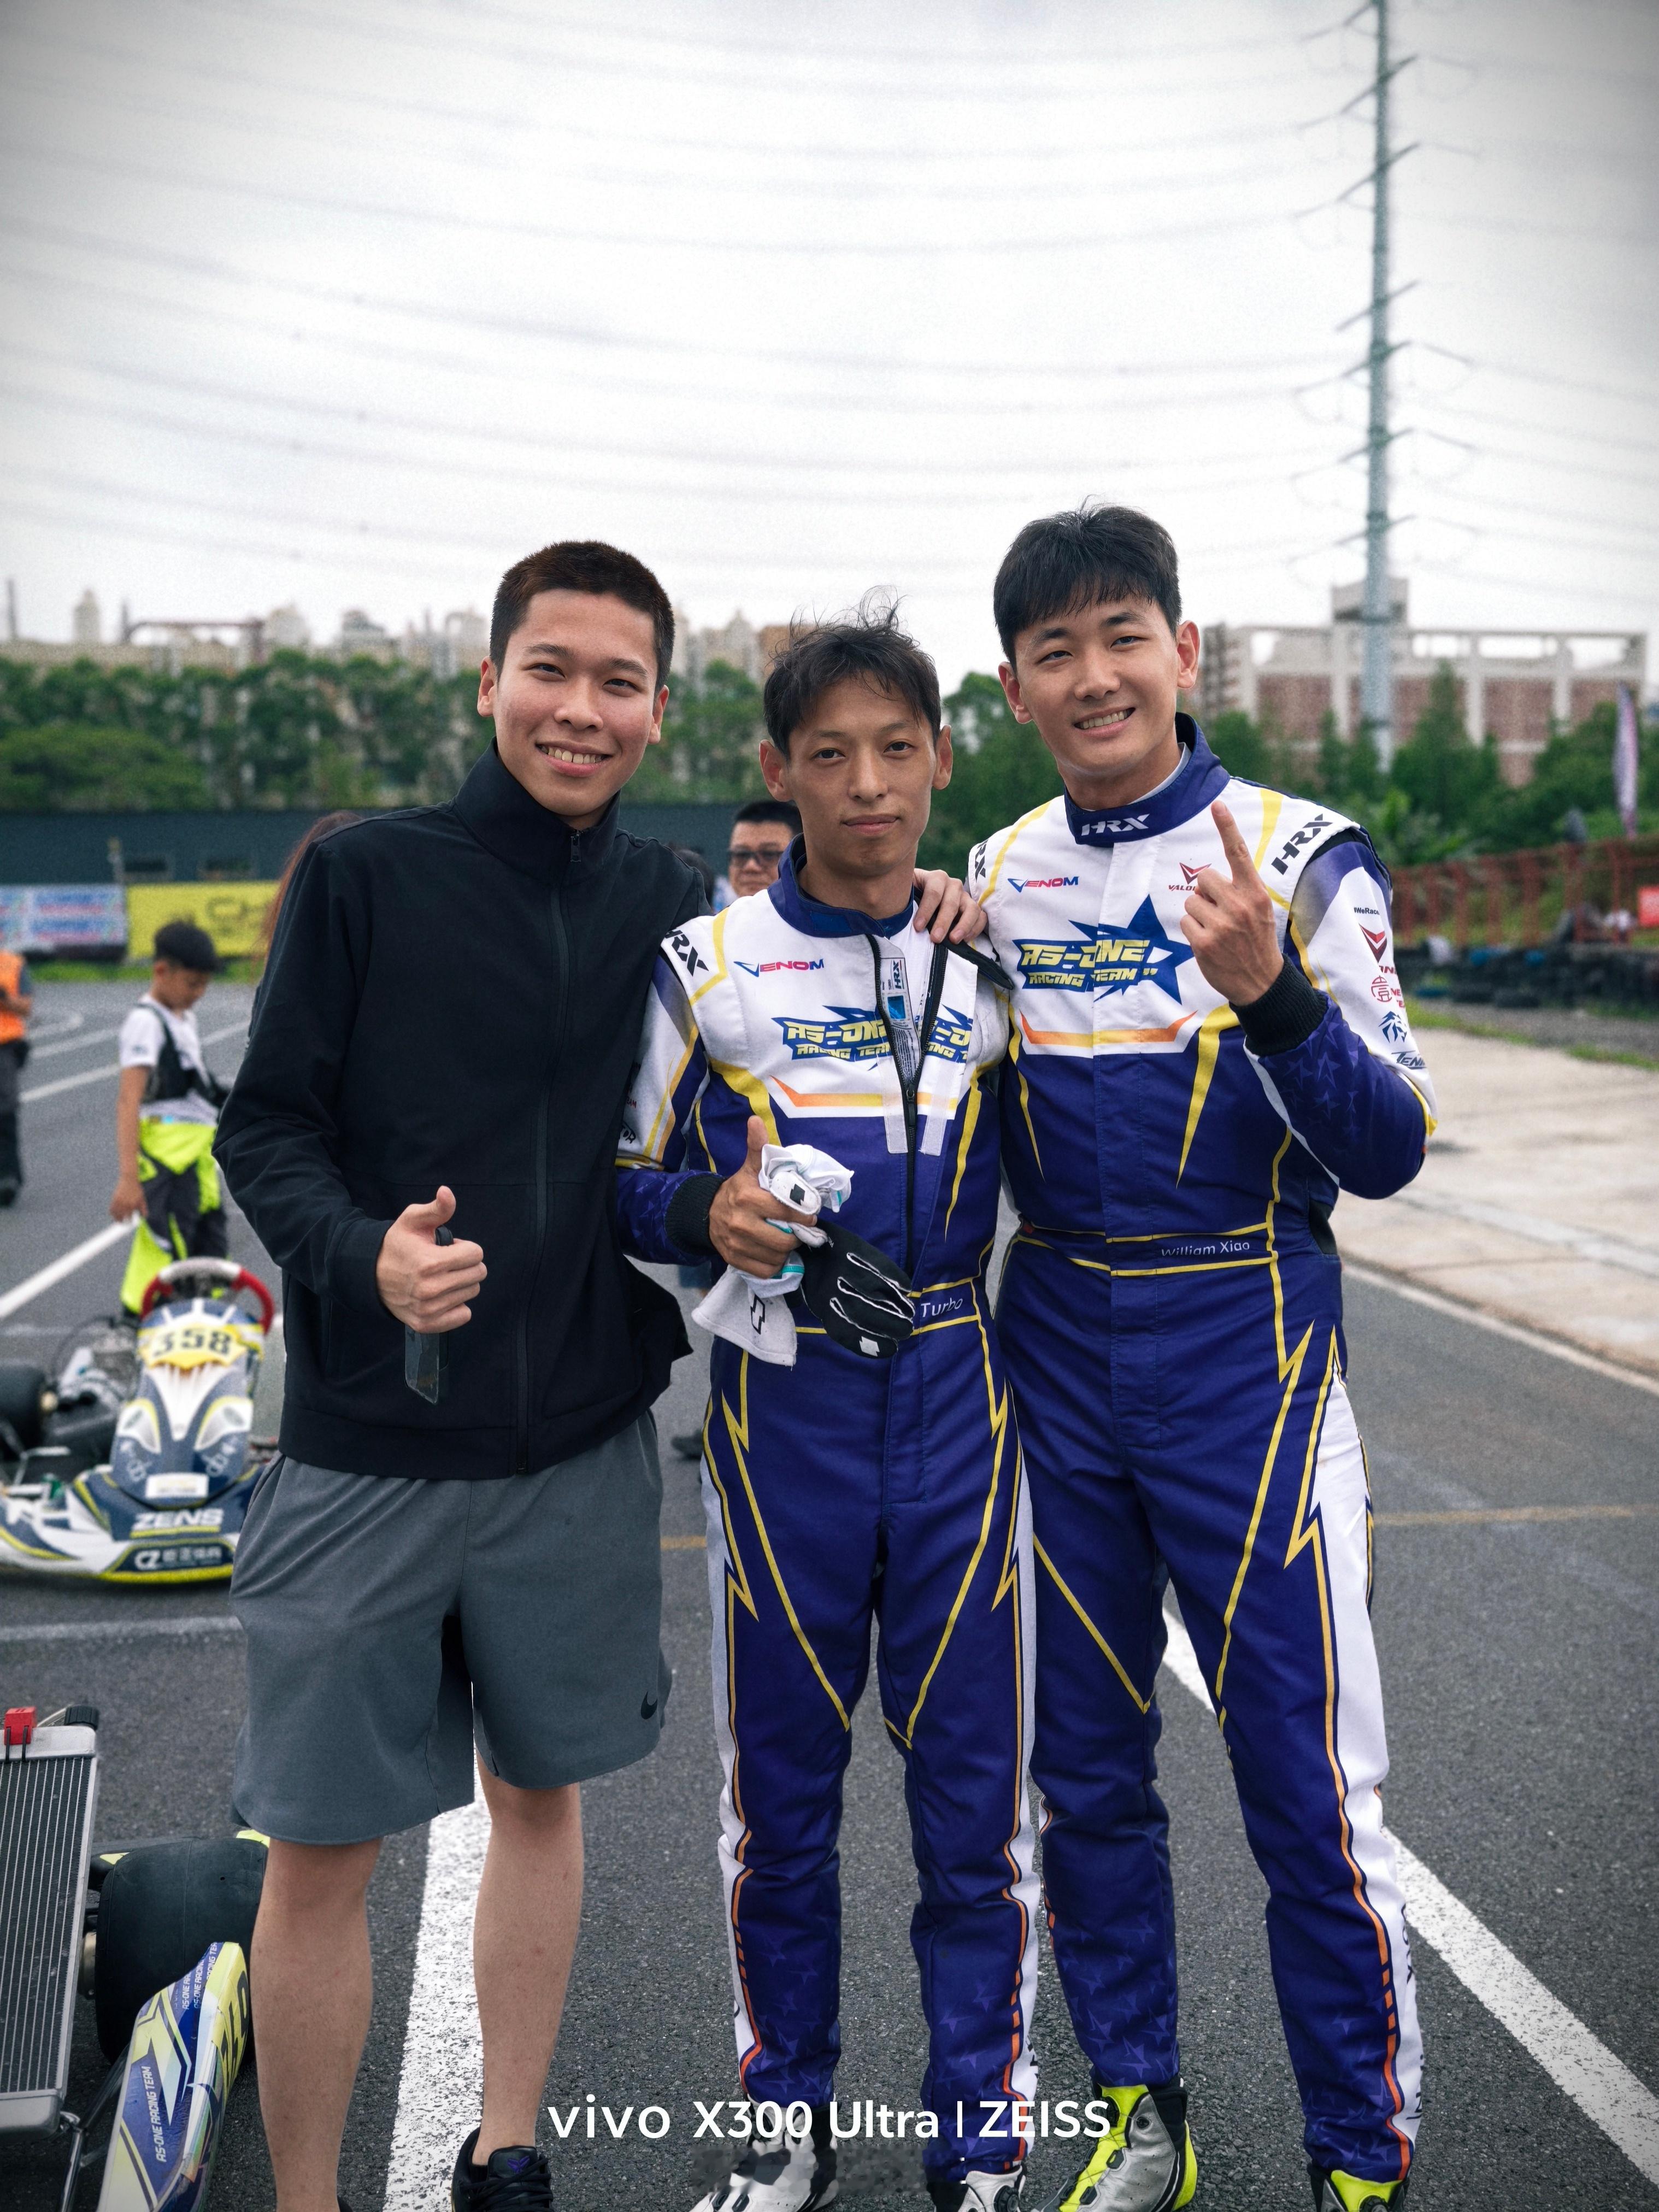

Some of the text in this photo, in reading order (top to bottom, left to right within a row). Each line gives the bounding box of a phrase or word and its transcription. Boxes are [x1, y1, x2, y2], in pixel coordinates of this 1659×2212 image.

[1081, 814, 1150, 836] HRX
[1271, 813, 1333, 875] HRX
[1007, 876, 1080, 893] VENOM
[1021, 940, 1150, 968] AS-ONE
[733, 958, 824, 978] VENOM
[893, 960, 902, 989] HRX
[1027, 968, 1138, 987] RACING TEAM
[1162, 1240, 1250, 1256] William Xiao
[921, 1297, 963, 1317] Turbo
[142, 2066, 155, 2090] TEAM
[146, 2092, 161, 2125] RACING
